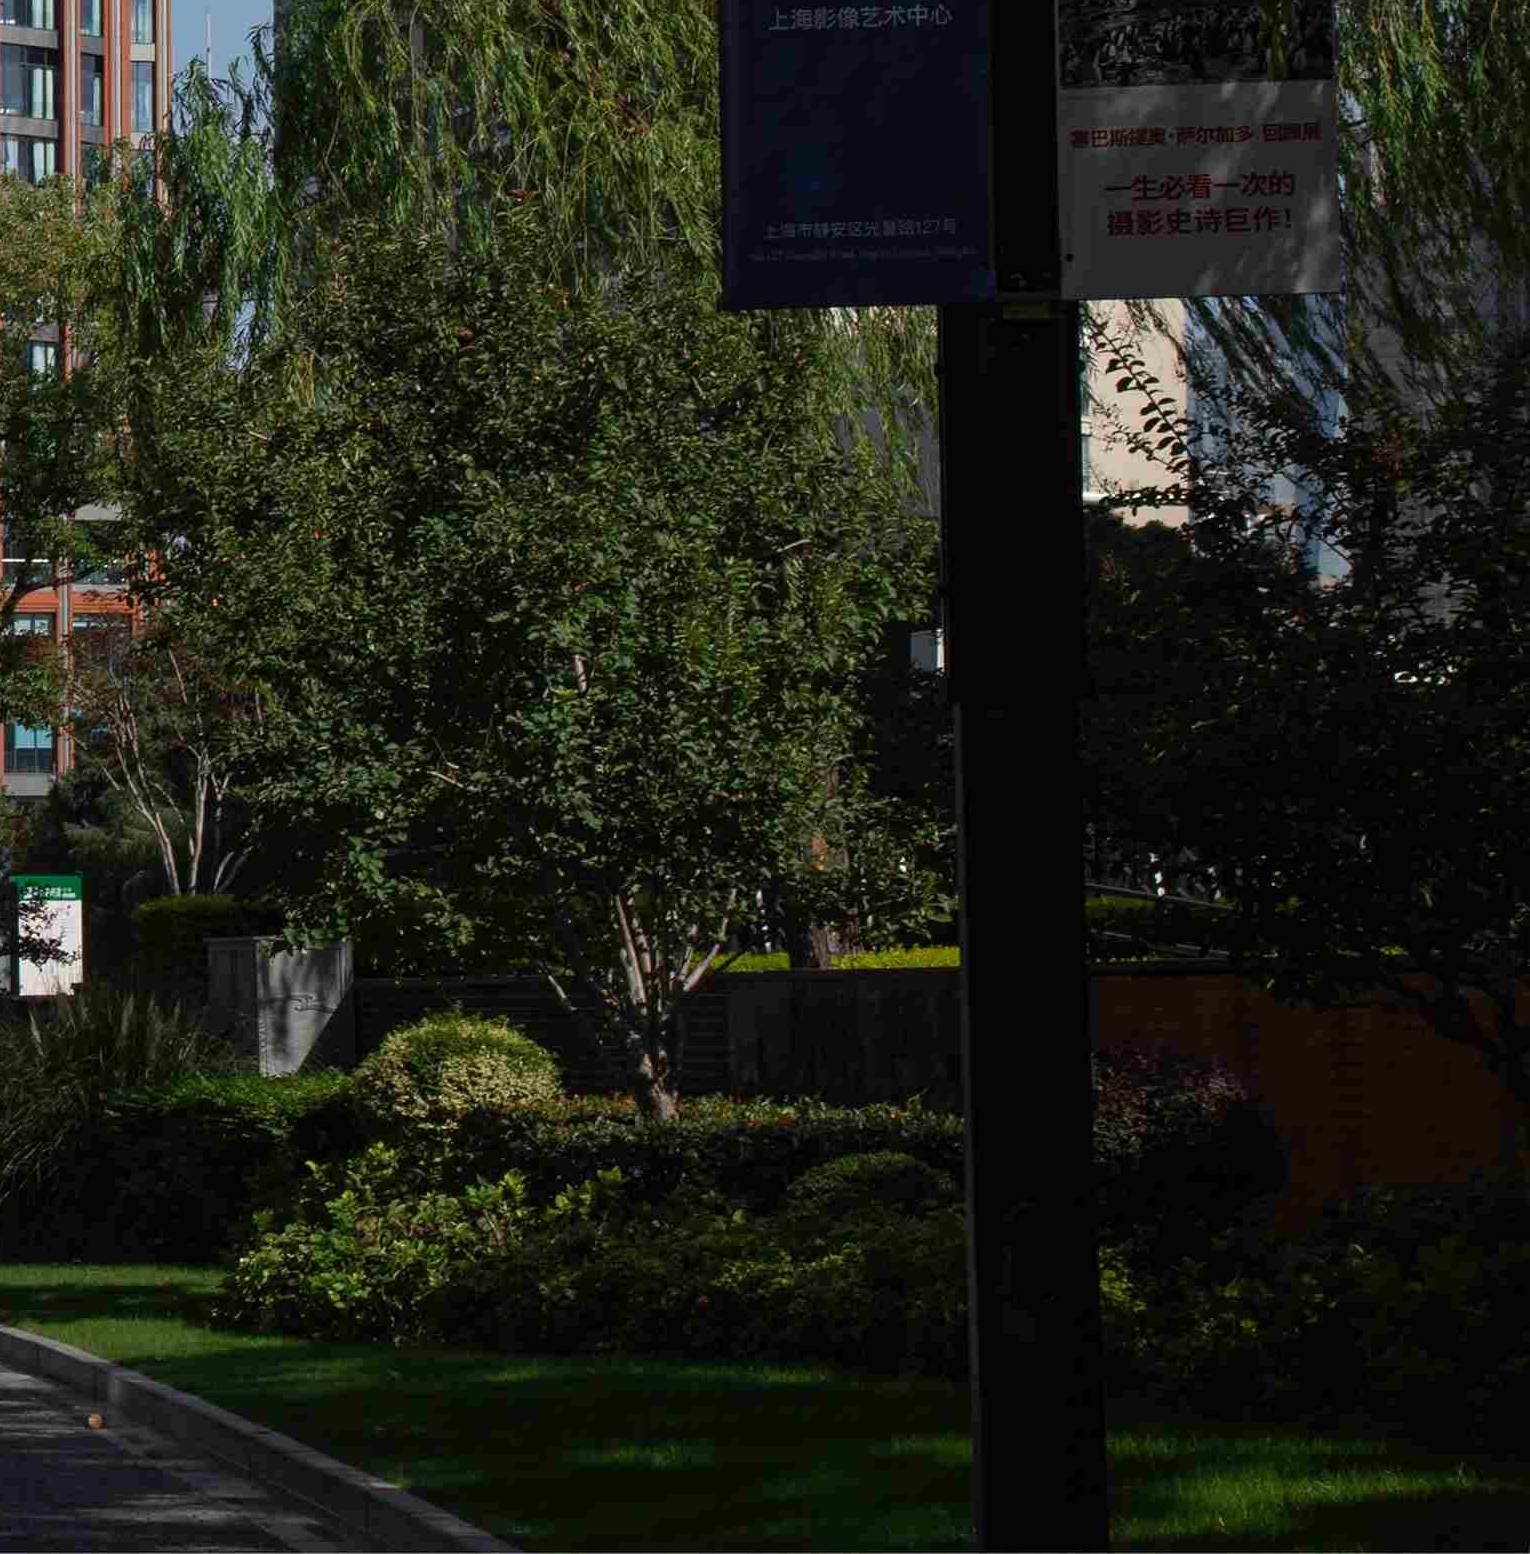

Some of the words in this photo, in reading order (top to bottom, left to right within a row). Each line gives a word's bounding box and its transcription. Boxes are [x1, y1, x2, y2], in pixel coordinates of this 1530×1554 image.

[766, 4, 955, 31] 上海影像艺术中心
[1102, 169, 1296, 201] 一生必看一次的
[1106, 206, 1293, 237] 摄影史诗巨作!
